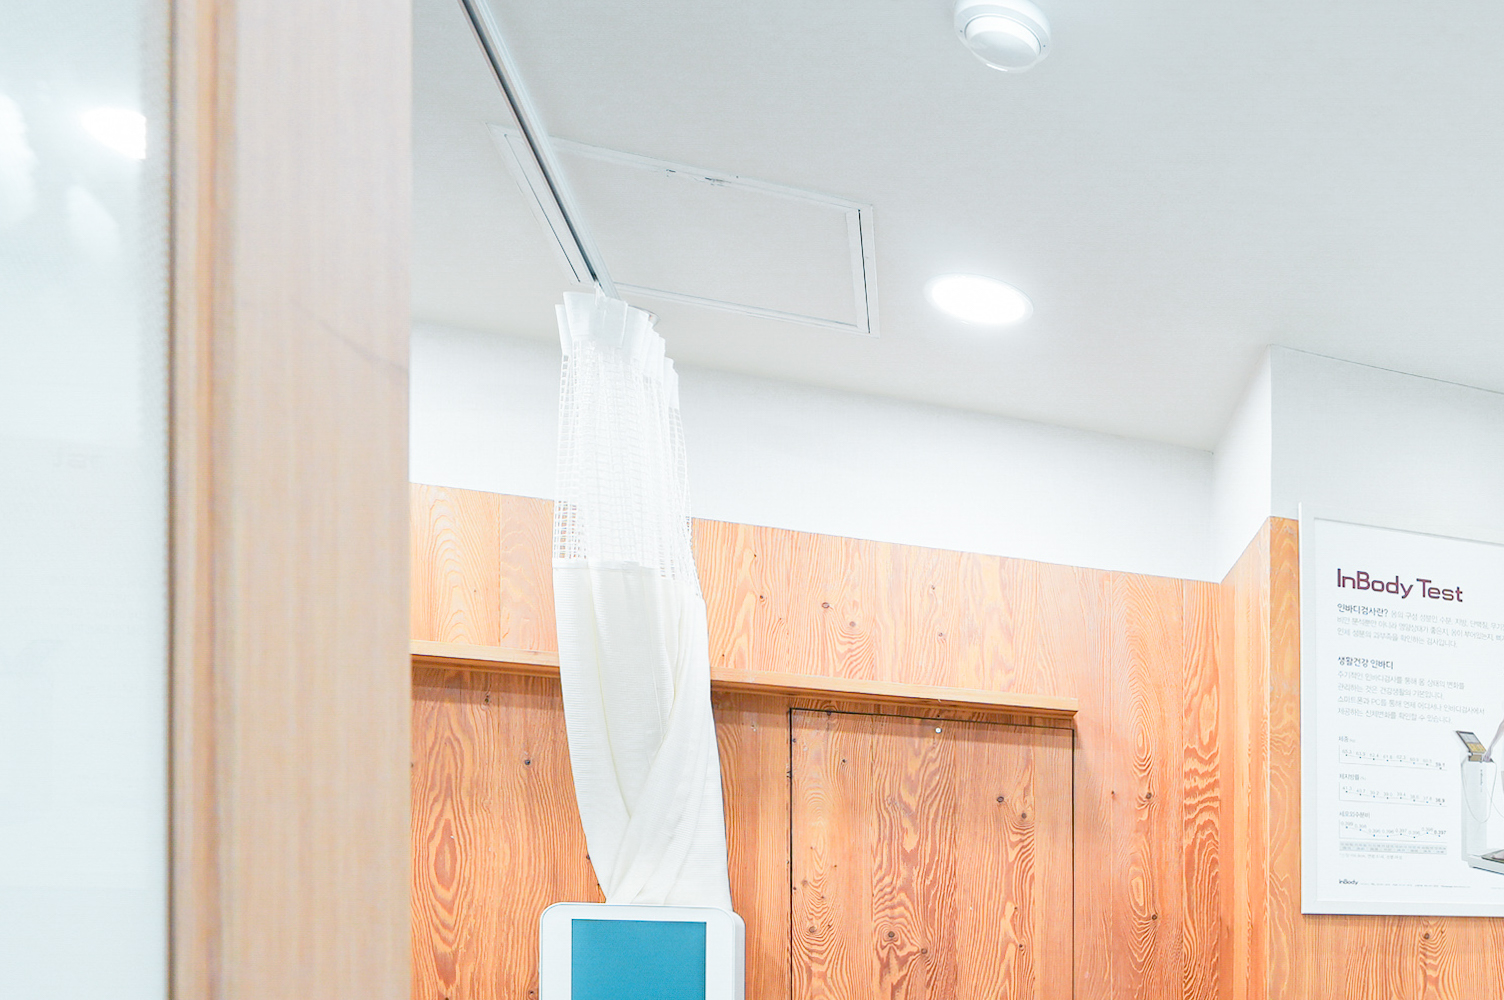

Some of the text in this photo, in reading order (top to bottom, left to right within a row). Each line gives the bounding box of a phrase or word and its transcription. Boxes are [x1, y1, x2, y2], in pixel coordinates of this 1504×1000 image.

[1337, 568, 1463, 602] InBody Test
[1337, 603, 1388, 617] 인바디검사란?
[1338, 656, 1393, 669] 생활건강 인바디
[1338, 683, 1363, 692] 관리하는
[1338, 707, 1363, 717] 제공하는
